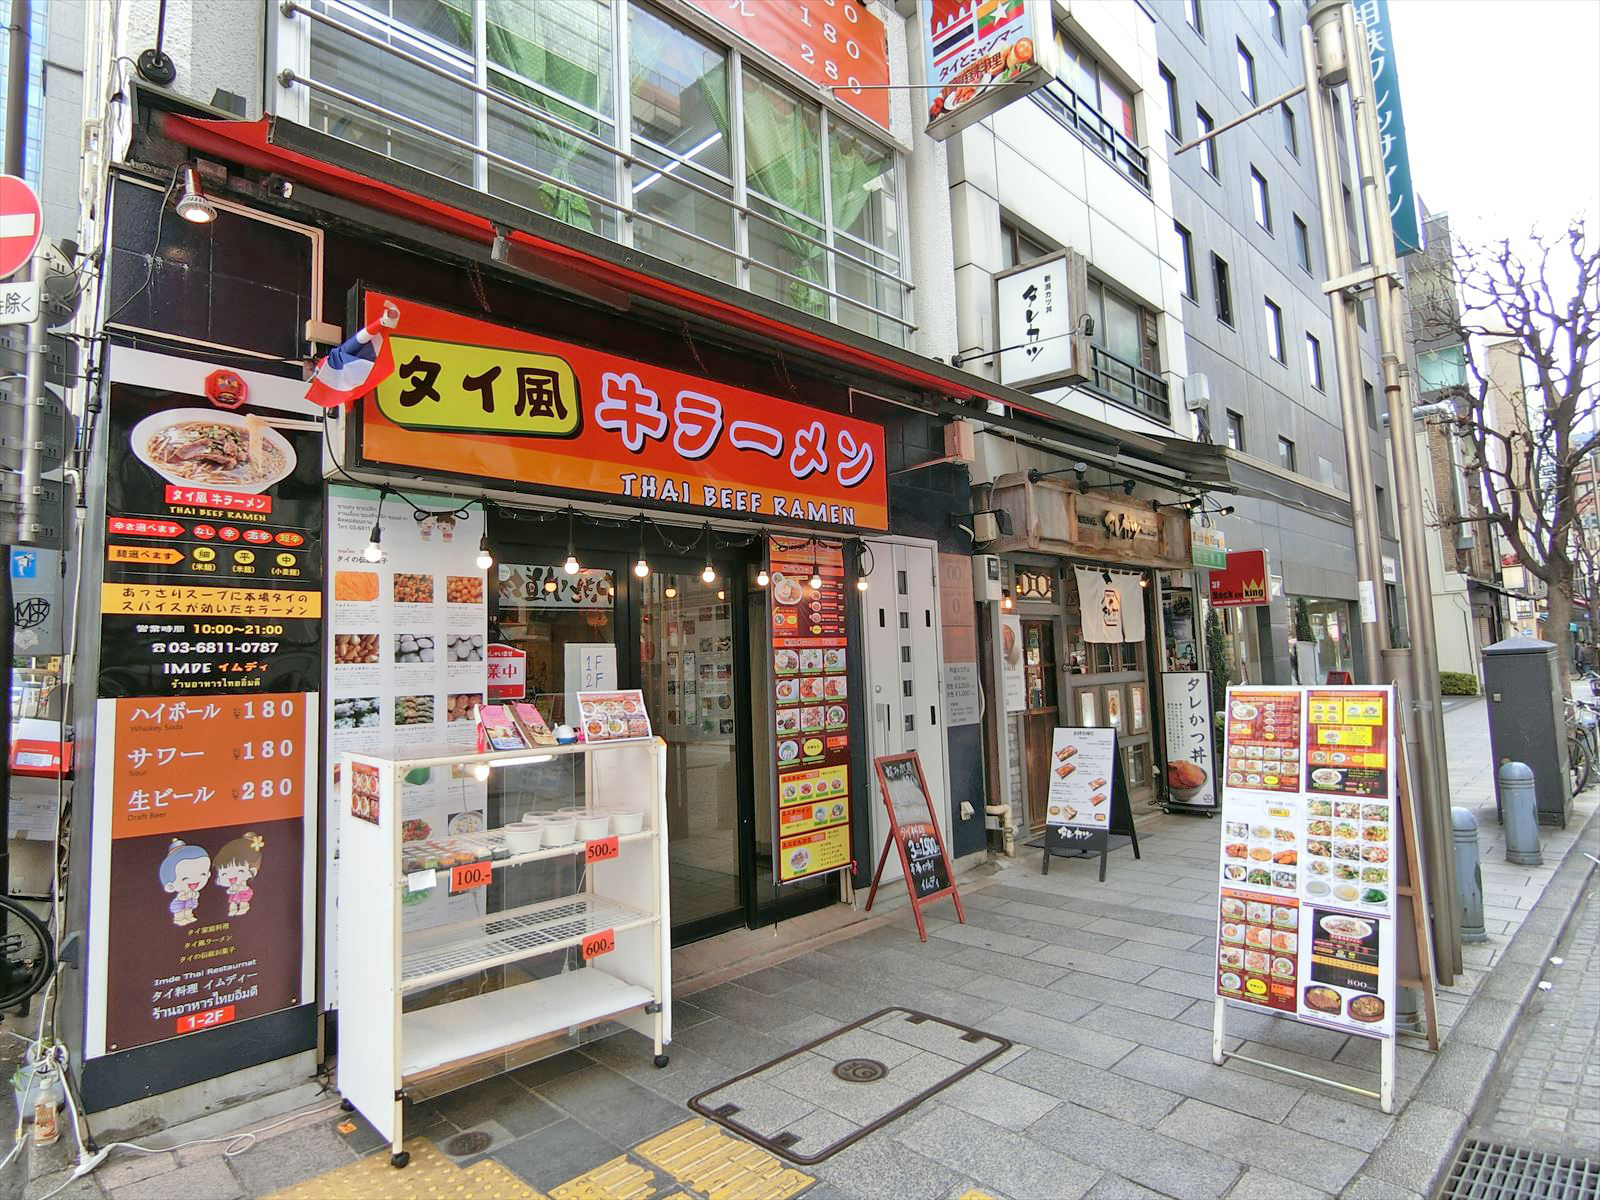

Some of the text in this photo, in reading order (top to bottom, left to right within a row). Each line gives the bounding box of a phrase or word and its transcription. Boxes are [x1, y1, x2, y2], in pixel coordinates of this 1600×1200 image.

[939, 25, 1023, 82] タイとミャンマー
[0, 292, 32, 315] 除く
[398, 354, 874, 487] タイ風 牛ラーメン
[172, 489, 266, 509] タイ風 牛ラーメン
[620, 473, 856, 526] THAI BEEF RAMEN
[170, 506, 267, 522] THAI BEEF RAMEN
[239, 552, 251, 561] 平
[281, 555, 292, 564] 中
[122, 587, 308, 603] あっさりスープに本場タイの
[1244, 588, 1264, 598] king
[122, 601, 308, 615] スパイスが効いた牛ラーメン
[136, 624, 185, 633] 営業時間
[164, 662, 212, 674] IMDE
[586, 655, 602, 671] 1F
[586, 673, 604, 688] 2F
[130, 701, 221, 724] ハイボール
[244, 699, 294, 719] 180
[130, 723, 184, 733] Whiskey Soda
[1187, 677, 1207, 764] タレかつ丼
[127, 747, 205, 769] サワー
[243, 739, 293, 760] 180
[128, 769, 147, 777] Sour
[128, 785, 216, 812] 生ビール
[241, 778, 292, 800] 280
[127, 811, 167, 822] Draft Beer
[1057, 825, 1093, 840] タレカツ
[587, 842, 617, 859] 500.-
[455, 867, 490, 887] 100.-
[585, 938, 615, 956] 600.-
[154, 975, 182, 987] Imde
[184, 970, 205, 981] Thai
[1346, 978, 1368, 988] 800
[152, 972, 258, 1003] タイ料理 イムディー
[187, 1009, 225, 1029] 1-2F
